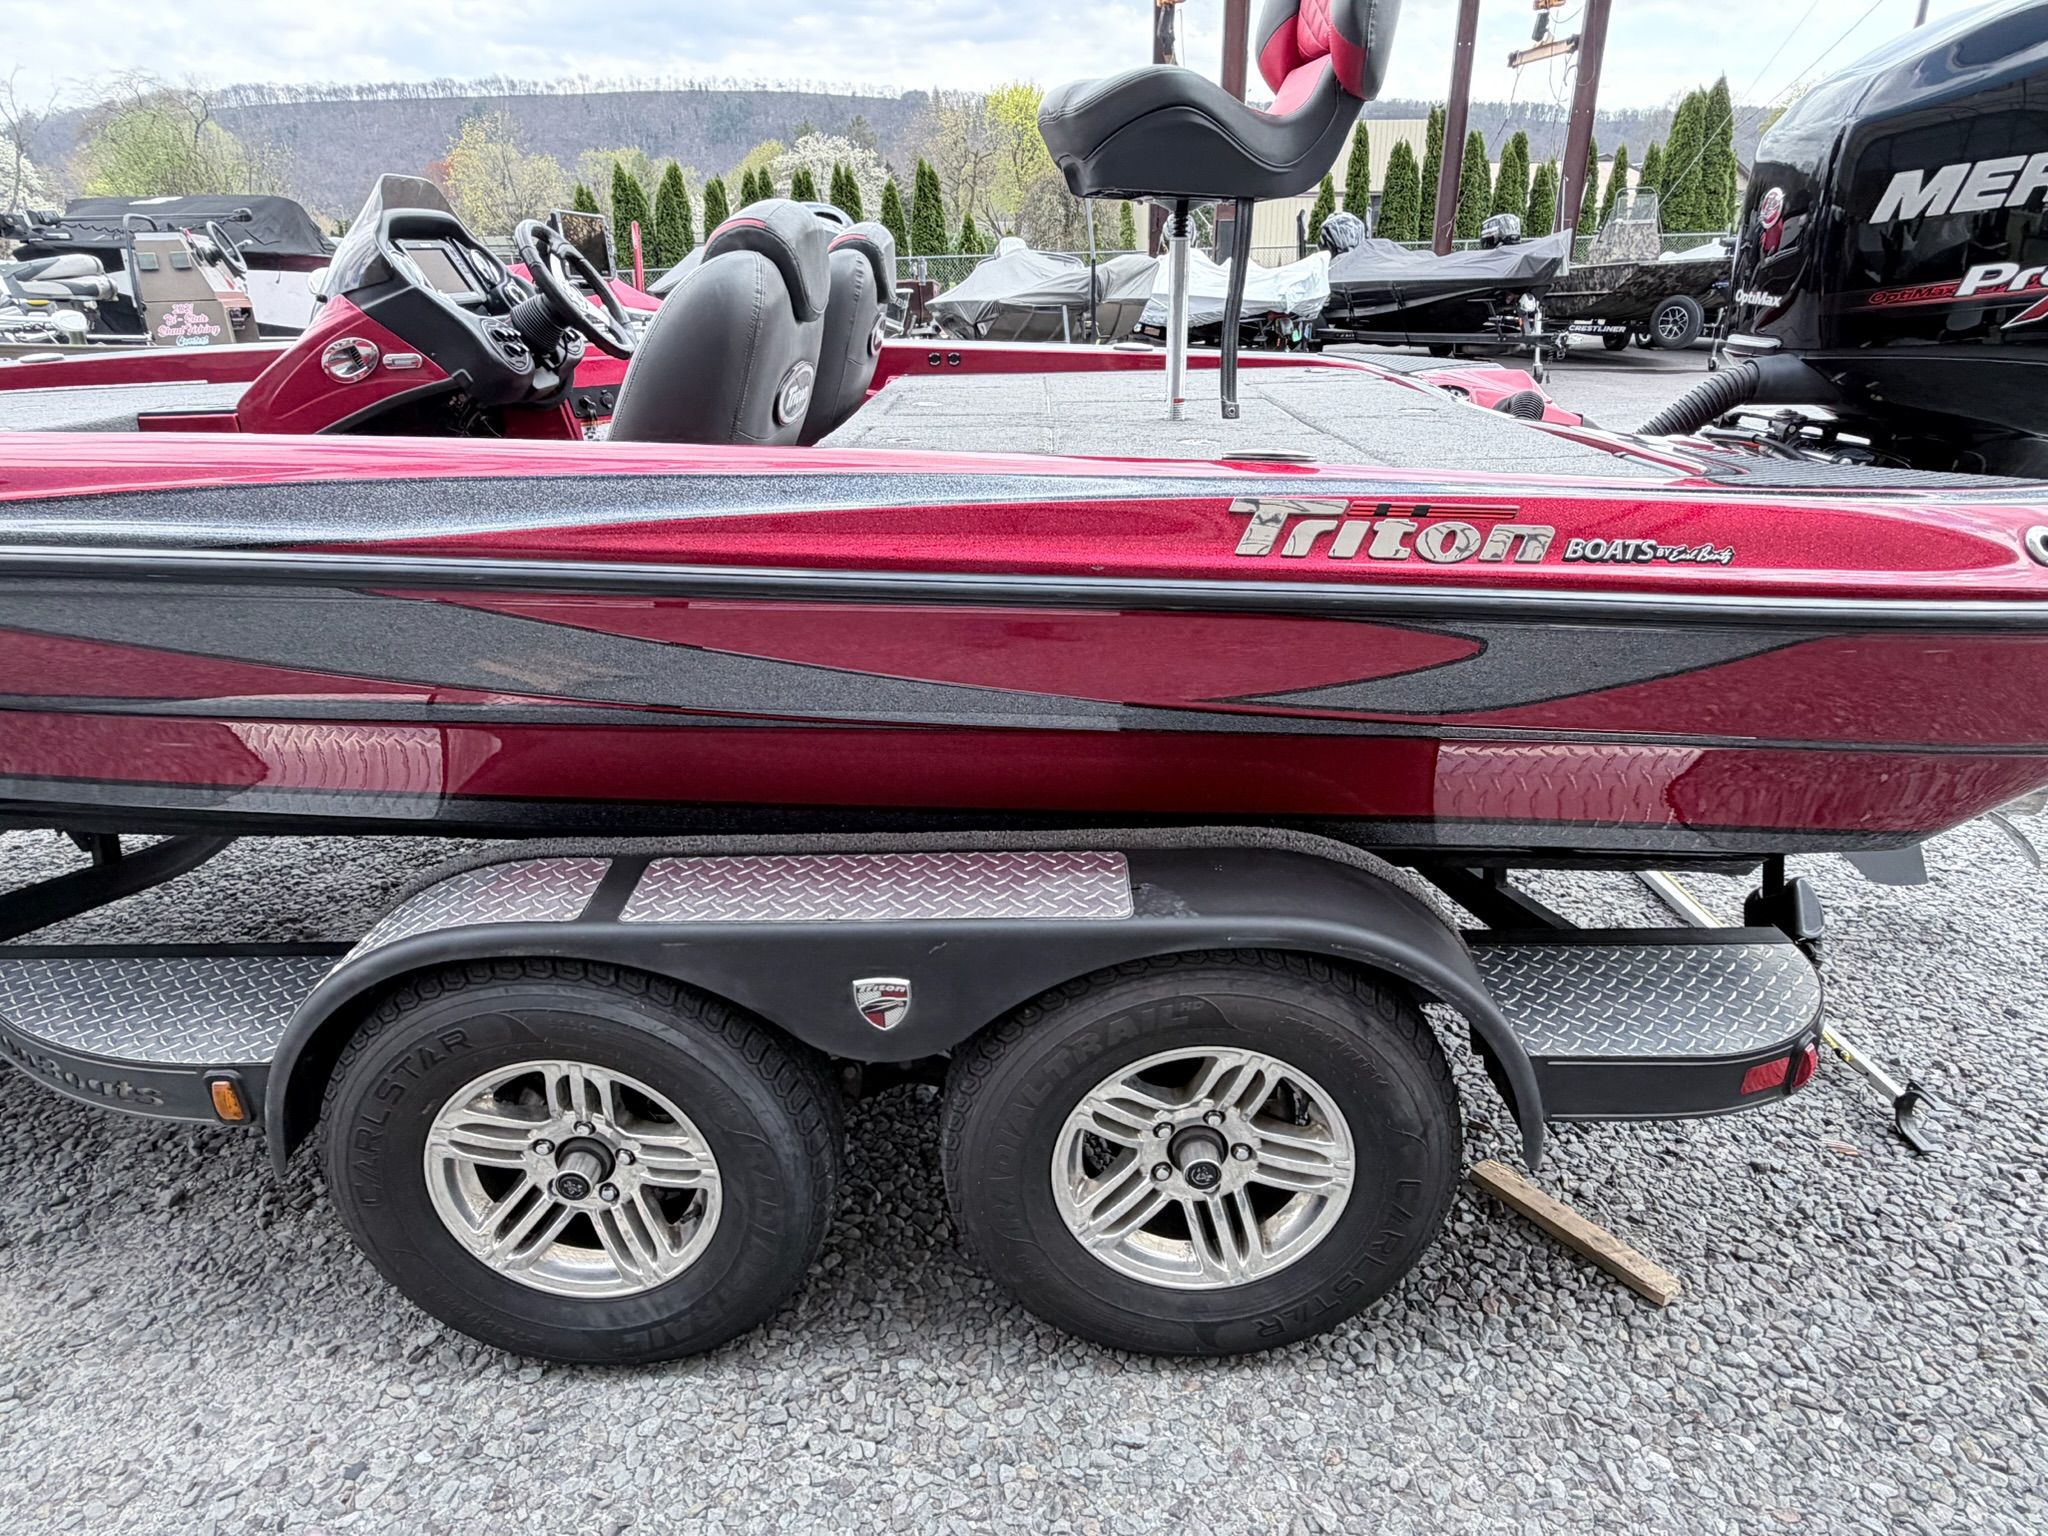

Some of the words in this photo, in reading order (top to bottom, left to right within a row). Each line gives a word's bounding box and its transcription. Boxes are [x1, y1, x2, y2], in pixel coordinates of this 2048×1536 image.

[1954, 262, 2048, 297] Pr
[1736, 289, 1782, 307] OptiMax
[1568, 324, 1627, 333] CRESTLINER
[1229, 497, 1556, 563] Triton
[1562, 538, 1658, 563] BOATS
[1656, 547, 1672, 558] BY
[857, 983, 906, 993] Triton
[352, 1026, 473, 1208] CARLSTAR
